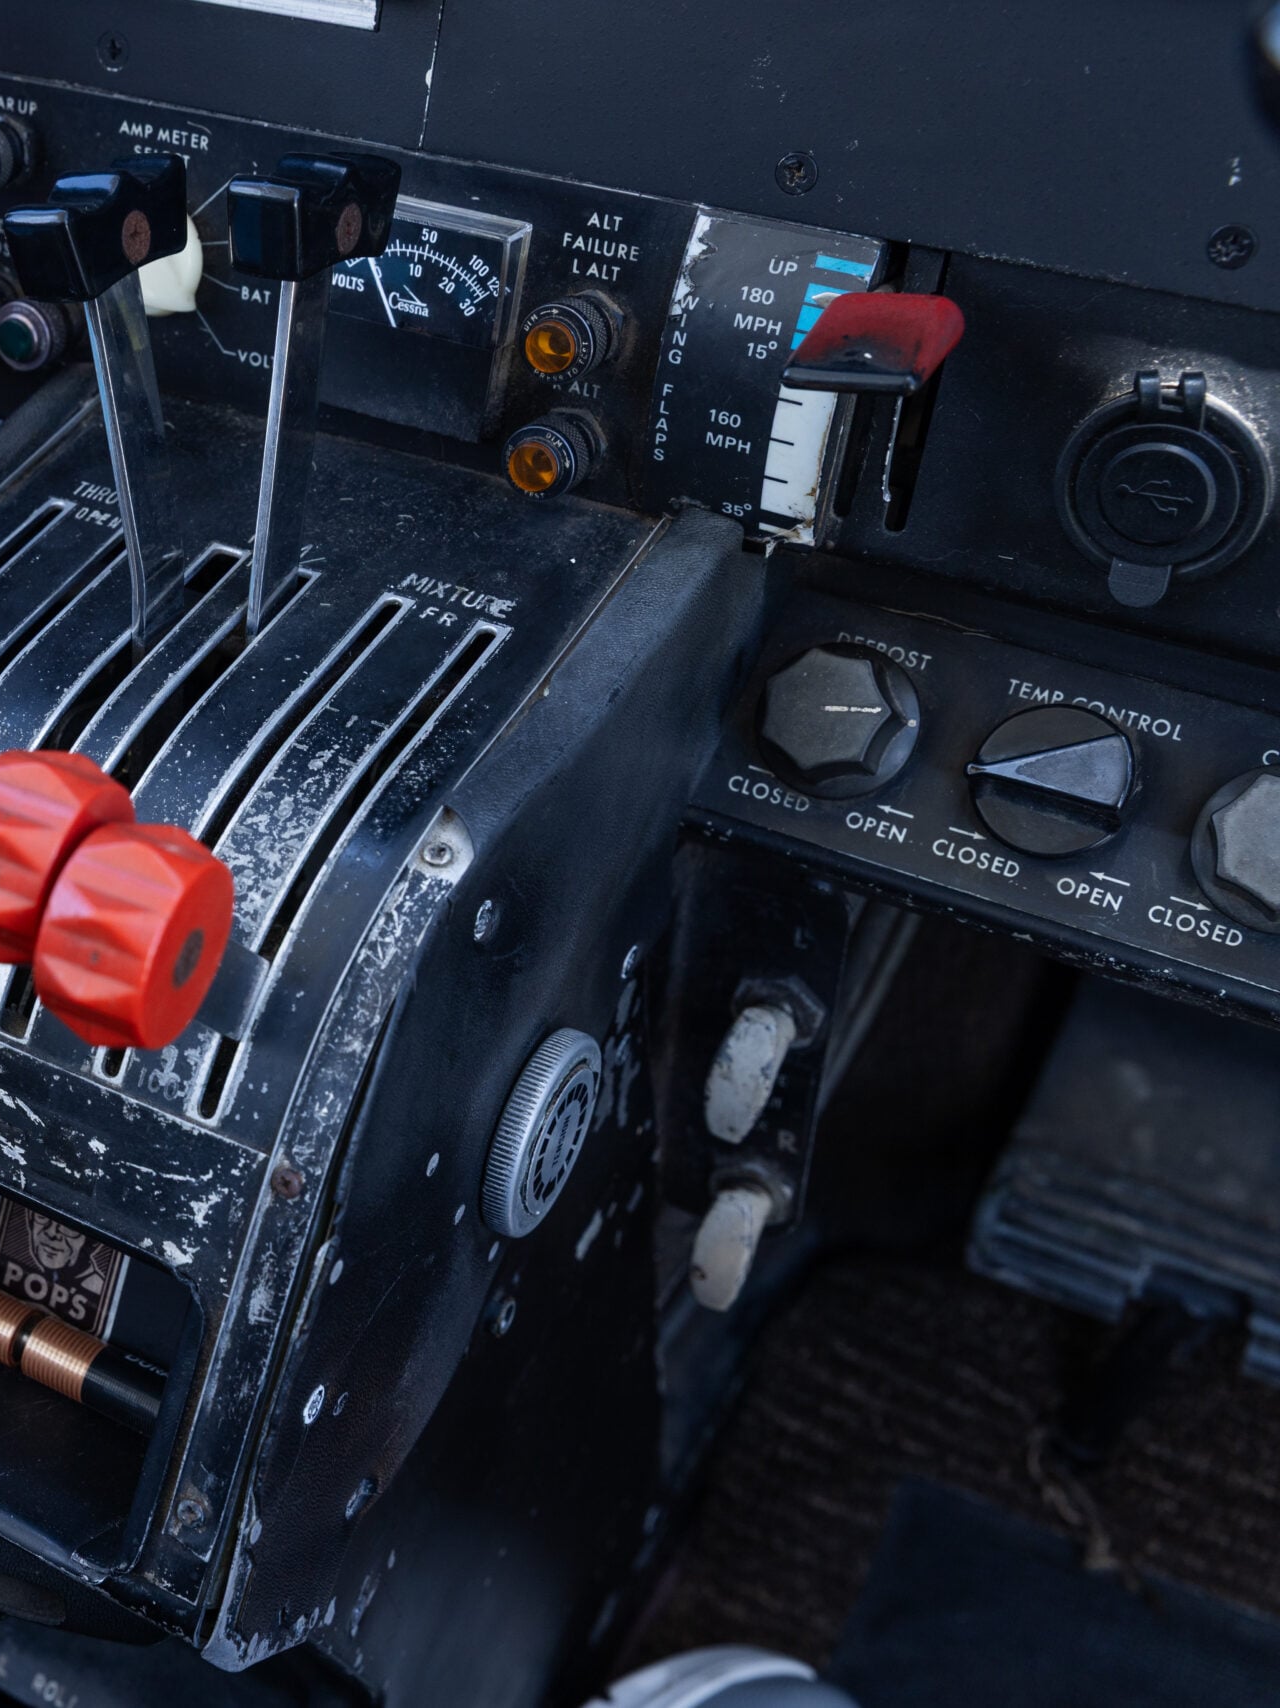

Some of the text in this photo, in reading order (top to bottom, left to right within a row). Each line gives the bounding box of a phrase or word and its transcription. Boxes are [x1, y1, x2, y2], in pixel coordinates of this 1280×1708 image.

[17, 99, 38, 116] UP
[119, 120, 209, 151] AMP METER
[587, 212, 623, 232] ALT
[421, 228, 438, 244] 50
[562, 232, 640, 262] FAILURE
[409, 263, 422, 278] 10
[468, 254, 490, 277] 100
[572, 258, 621, 282] L ALT
[769, 258, 798, 277] UP
[332, 272, 365, 293] VOLTS
[438, 276, 456, 295] 20
[240, 286, 272, 305] BAT
[388, 291, 429, 318] Cessna
[740, 286, 775, 305] 180
[458, 298, 476, 317] 30
[668, 295, 700, 365] WING
[733, 313, 782, 336] MPH
[237, 349, 274, 369] VOL
[747, 341, 778, 359] 15°
[568, 380, 601, 399] ALT
[653, 383, 674, 462] FLAPS
[709, 408, 742, 428] 160
[705, 431, 752, 455] MPH
[73, 480, 118, 505] THRO
[721, 502, 753, 517] 35°
[397, 572, 519, 619] MIXTURE
[1007, 678, 1065, 705] TEMP
[728, 775, 810, 813] CLOSED
[845, 811, 908, 844] OPEN
[932, 838, 1021, 879] CLOSED
[1056, 877, 1123, 912] OPEN
[1147, 905, 1243, 947] CLOSED
[2, 1260, 89, 1321] POP'S
